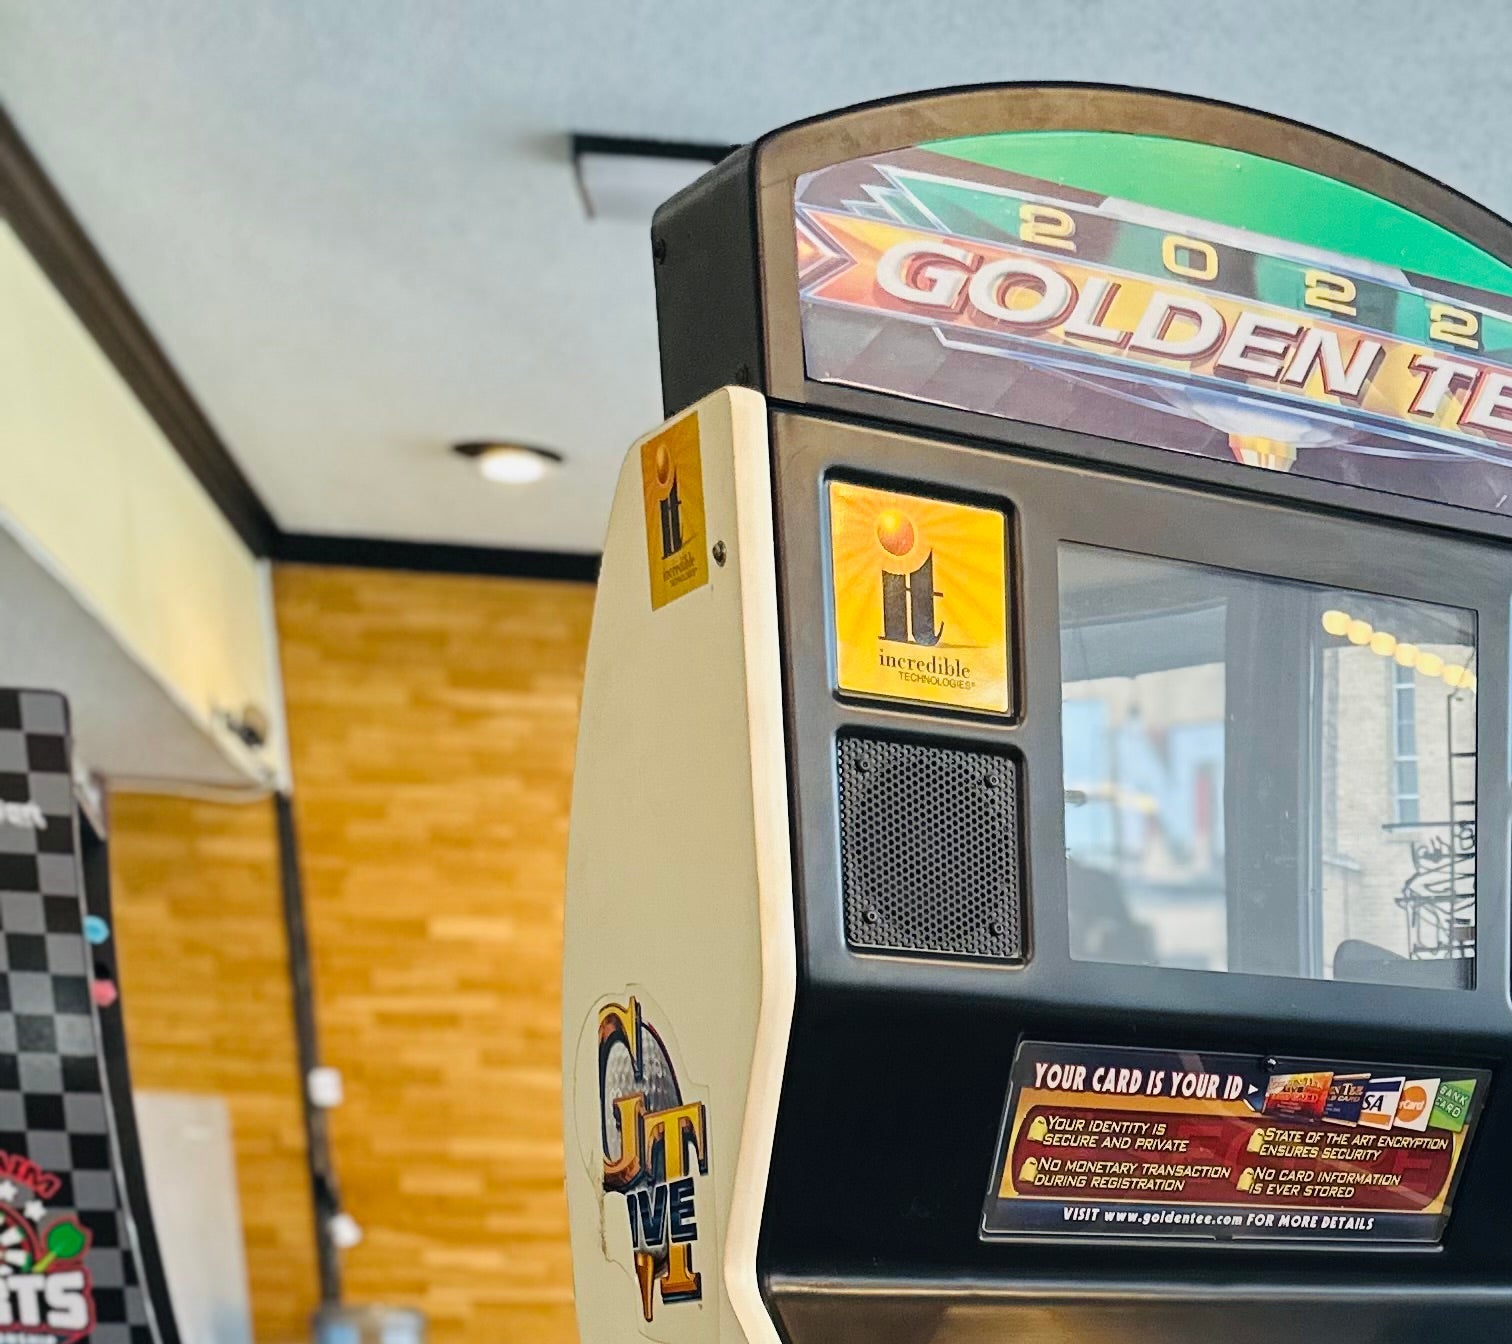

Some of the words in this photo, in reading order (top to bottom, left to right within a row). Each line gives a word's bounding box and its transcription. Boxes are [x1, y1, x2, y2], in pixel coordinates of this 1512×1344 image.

[877, 240, 1385, 398] GOLDEN
[878, 648, 971, 680] incredible
[1034, 1062, 1087, 1091] YOUR
[1092, 1067, 1143, 1095] CARD
[1146, 1070, 1164, 1096] IS
[1169, 1072, 1221, 1099] YOUR
[1223, 1075, 1244, 1100] ID
[1439, 1085, 1469, 1106] BANK
[1047, 1115, 1085, 1131] YOUR
[1088, 1119, 1150, 1135] IDENTITY
[1152, 1123, 1167, 1136] IS
[1042, 1133, 1098, 1148] SECURE
[1101, 1136, 1132, 1150] AND
[1134, 1138, 1190, 1152] PRIVATE
[1264, 1128, 1304, 1144] STATE
[1305, 1131, 1324, 1144] OF
[1326, 1132, 1350, 1146] THE
[1351, 1134, 1376, 1147] ART
[1377, 1135, 1449, 1151] ENCRYPTION
[1259, 1144, 1320, 1159] ENSURES
[1321, 1147, 1383, 1161] SECURITY
[1037, 1157, 1060, 1171] NO
[1064, 1160, 1139, 1175] MONETARY
[1142, 1162, 1232, 1179] TRANSACTION
[1253, 1166, 1275, 1181] NO
[1278, 1169, 1314, 1182] CARD
[1317, 1171, 1402, 1187] INFORMATION
[1034, 1175, 1088, 1188] DURING
[1090, 1177, 1186, 1192] REGISTRATION
[1249, 1183, 1262, 1195] IS
[1266, 1184, 1300, 1196] EVER
[1303, 1185, 1355, 1198] STORED
[1063, 1207, 1100, 1222] VISIT
[1104, 1210, 1243, 1226] www.goldentee.com
[1246, 1213, 1275, 1227] FOR
[1278, 1214, 1318, 1229] MORE
[1321, 1216, 1375, 1231] DETAILS
